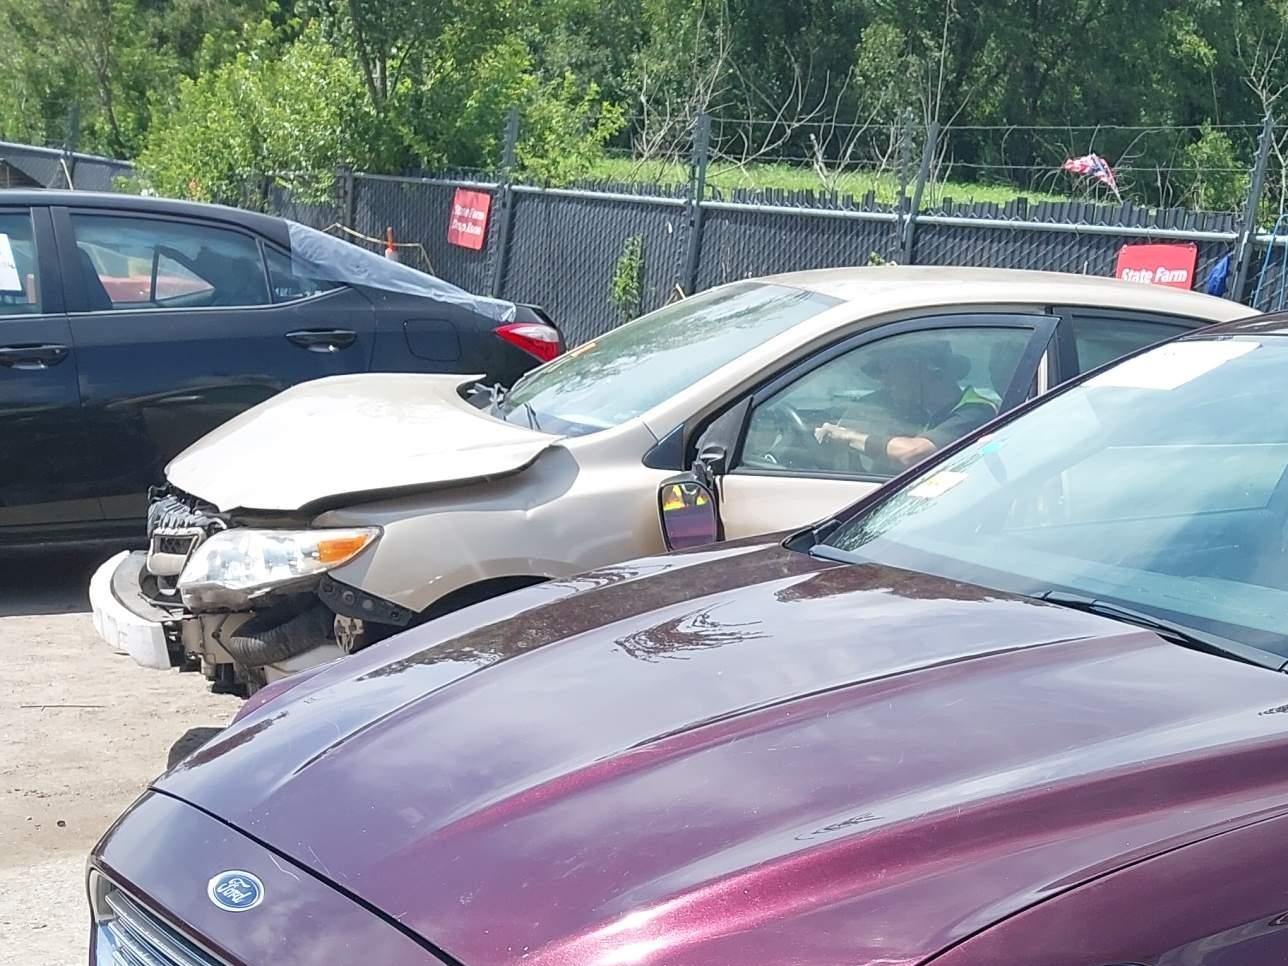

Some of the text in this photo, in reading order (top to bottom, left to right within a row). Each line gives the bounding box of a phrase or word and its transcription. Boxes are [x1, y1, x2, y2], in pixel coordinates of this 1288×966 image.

[1121, 266, 1188, 283] State Farm
[216, 877, 252, 904] Ford
